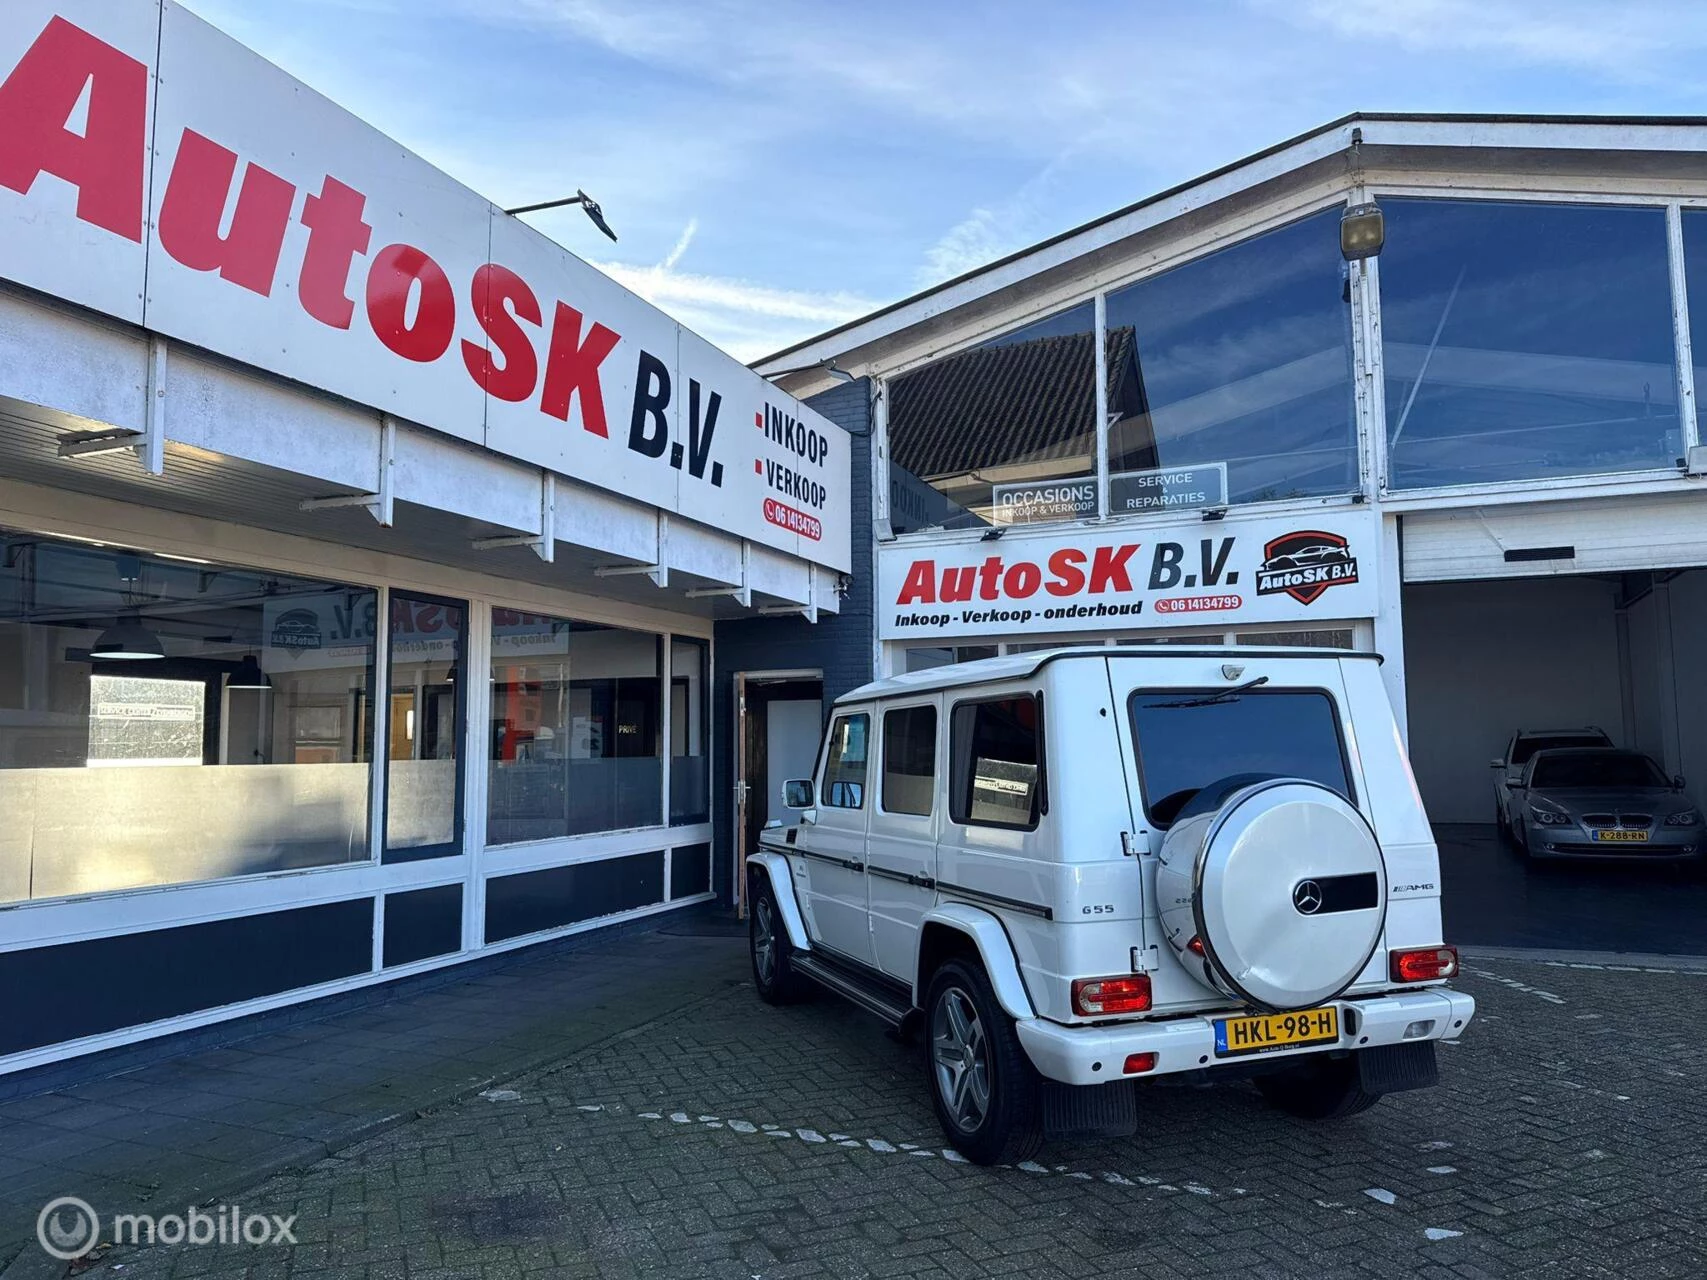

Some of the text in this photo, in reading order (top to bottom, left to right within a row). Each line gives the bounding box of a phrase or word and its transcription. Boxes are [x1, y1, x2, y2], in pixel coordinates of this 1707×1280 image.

[0, 14, 724, 489] AutoSK B.V.
[765, 401, 828, 468] INKOOP
[766, 458, 827, 510] VERKOOP
[1138, 472, 1193, 488] SERVICE
[1002, 485, 1094, 507] OCCASIONS
[1002, 501, 1095, 518] INKOOP & VERKOOP
[1126, 492, 1206, 509] REPARATIES
[775, 504, 820, 539] 06 14134799
[896, 536, 1239, 605] AutoSK B.V.
[1260, 562, 1356, 591] AutoSK B.V.
[895, 613, 951, 628] Inkoop
[962, 609, 1032, 625] Verkoop
[1043, 600, 1143, 620] onderhoud
[1170, 596, 1240, 611] 06 14134799
[1234, 1012, 1331, 1045] HKL-98-H
